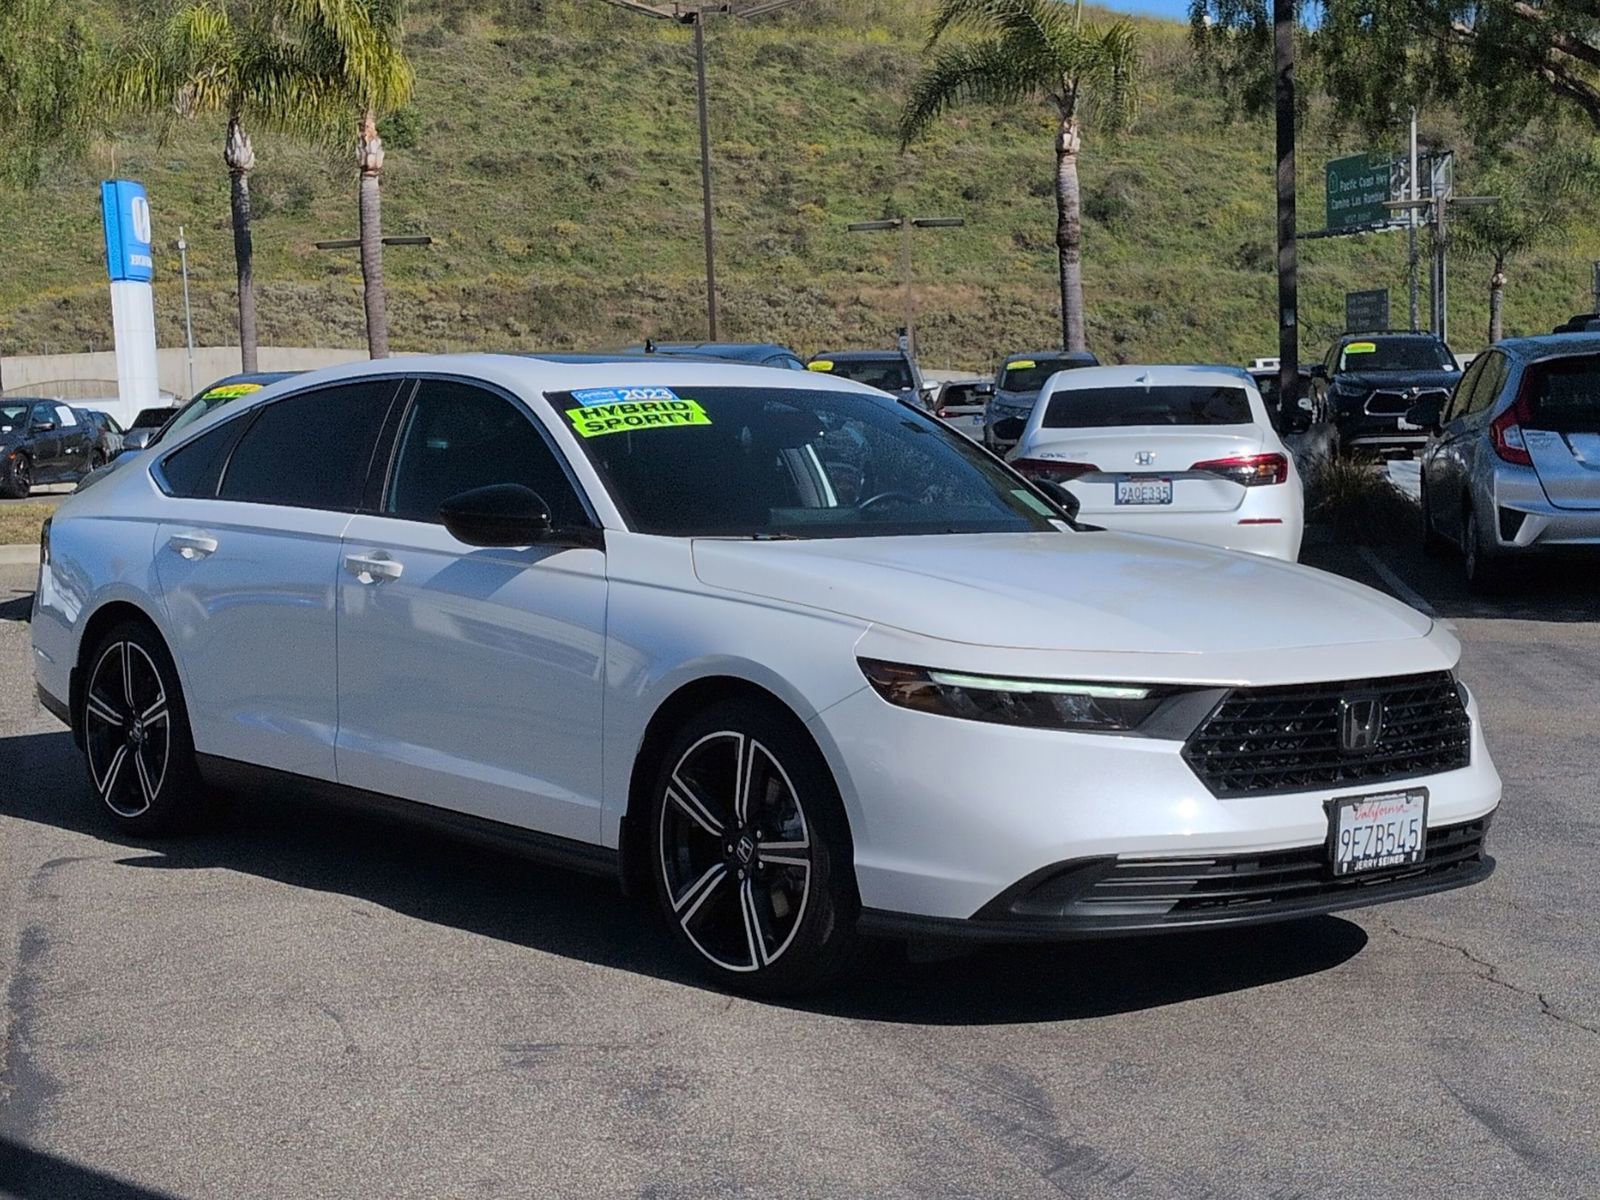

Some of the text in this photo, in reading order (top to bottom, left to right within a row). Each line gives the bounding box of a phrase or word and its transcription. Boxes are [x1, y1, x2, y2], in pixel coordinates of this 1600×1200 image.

[619, 388, 673, 400] 2023
[580, 401, 689, 419] HYBRID
[584, 412, 693, 432] SPORTY
[1354, 804, 1409, 822] California
[1340, 818, 1419, 862] 9EZB545
